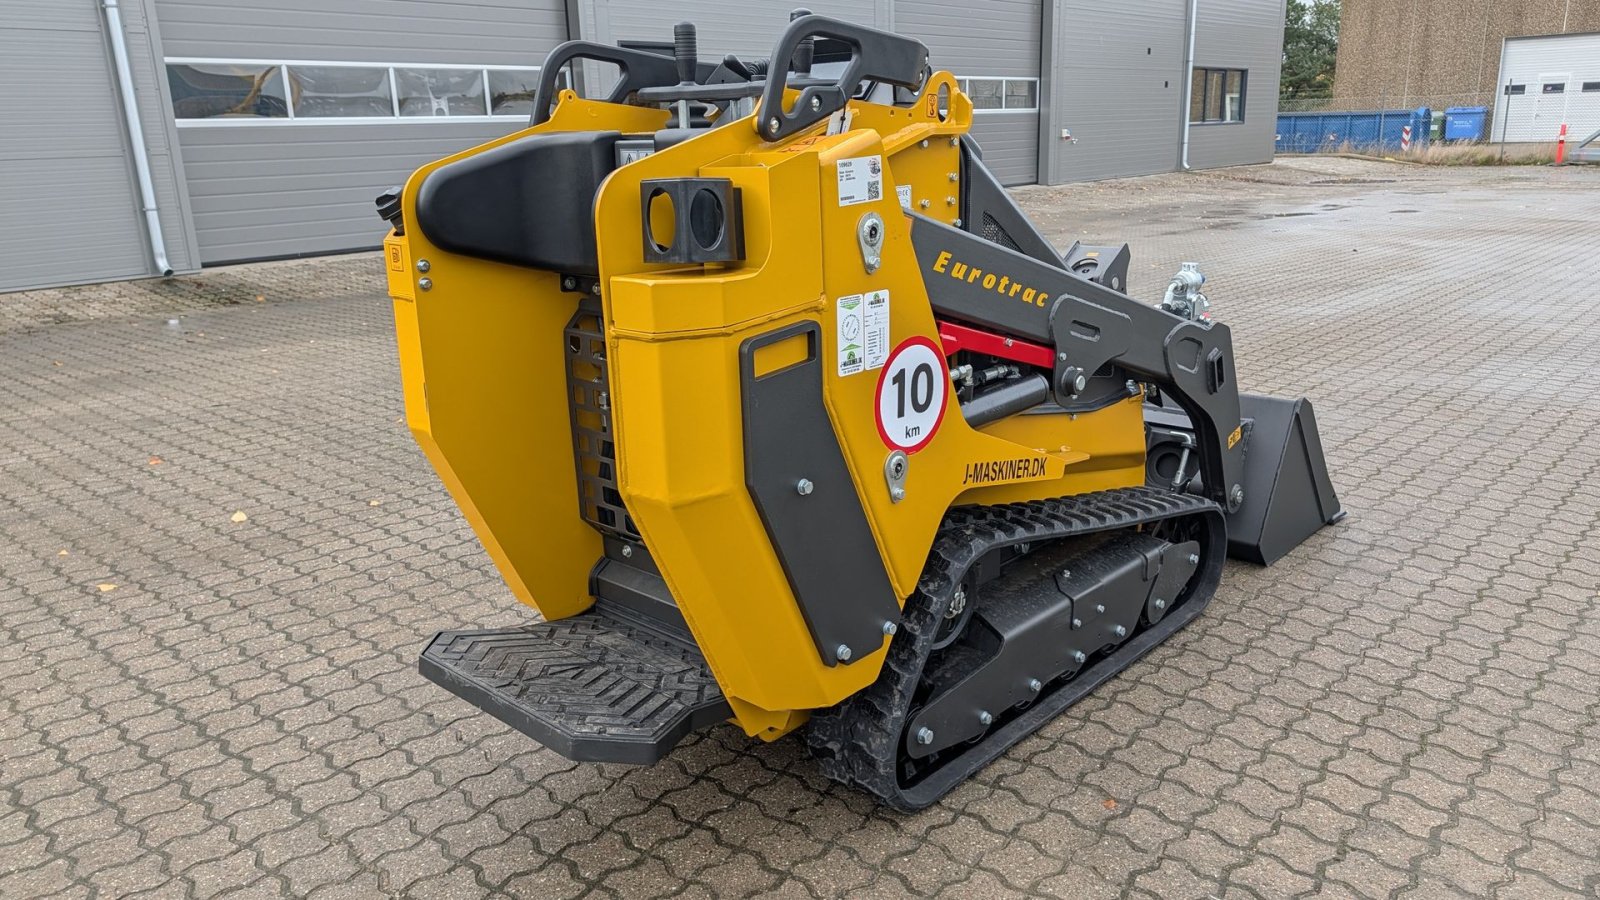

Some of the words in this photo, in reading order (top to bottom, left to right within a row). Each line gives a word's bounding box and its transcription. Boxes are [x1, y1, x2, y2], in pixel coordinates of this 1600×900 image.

[933, 250, 1049, 307] Eurotrac
[892, 362, 934, 419] 10
[905, 425, 921, 439] km
[962, 457, 1048, 485] J-MASKINER.DK
